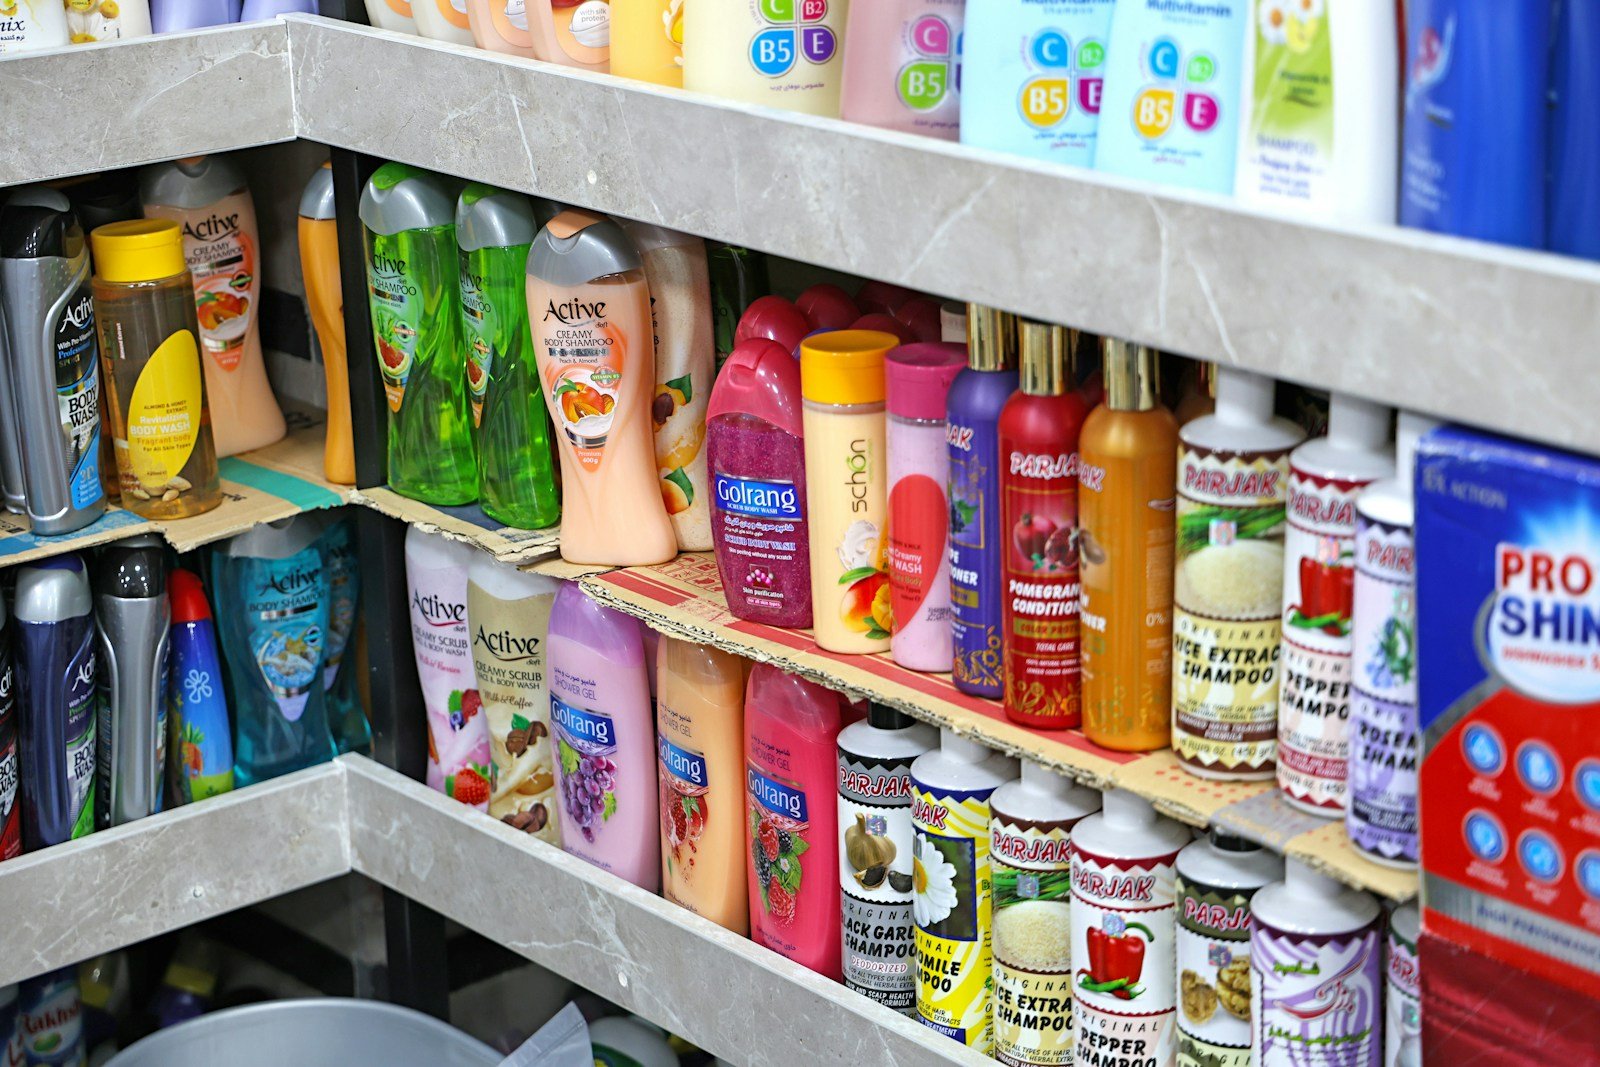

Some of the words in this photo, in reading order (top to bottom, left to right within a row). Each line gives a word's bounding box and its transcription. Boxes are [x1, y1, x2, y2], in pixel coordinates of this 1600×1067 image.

[805, 1, 823, 15] B2
[1146, 0, 1232, 17] Multivitamin
[581, 15, 606, 23] protein
[923, 26, 940, 47] C
[760, 39, 791, 63] B5
[813, 32, 824, 54] E
[1042, 38, 1058, 61] C
[1156, 50, 1171, 72] C
[908, 70, 942, 98] B5
[1029, 87, 1064, 115] B5
[1140, 96, 1170, 128] B5
[1191, 96, 1206, 126] E
[183, 212, 239, 241] Active
[193, 241, 231, 256] CREAMY
[204, 246, 246, 261] SHAMPOO
[376, 278, 417, 296] SHAMPOO
[543, 298, 607, 327] Active
[545, 338, 564, 347] BODY
[566, 337, 614, 347] SHAMPOO
[556, 330, 593, 339] CREAMY
[68, 385, 97, 414] BODY
[140, 413, 190, 424] Revitalizing
[166, 406, 188, 414] EXTRACT
[130, 425, 158, 435] BODY
[160, 422, 191, 433] WASH
[137, 436, 171, 446] Fragrant
[173, 434, 191, 442] body
[1184, 464, 1281, 498] PARJAK
[718, 479, 796, 513] Golrang
[727, 503, 743, 511] SCRUB
[745, 505, 760, 513] BODY
[724, 534, 747, 546] SCRUB
[748, 539, 770, 550] BODY
[770, 541, 797, 551] WASH
[752, 551, 767, 559] without
[895, 550, 922, 564] Creamy
[895, 560, 922, 574] WASH
[1502, 549, 1593, 597] PRO
[754, 589, 783, 599] purification
[249, 602, 279, 612] BODY
[412, 588, 466, 625] Active
[1500, 597, 1600, 645] SHIN
[428, 643, 444, 653] BODY
[445, 649, 466, 657] WASH
[438, 636, 468, 650] SCRUB
[474, 624, 540, 661] Active
[1036, 642, 1056, 652] TOTAL
[1057, 642, 1075, 651] CARE
[475, 660, 507, 679] CREAMY
[508, 671, 543, 681] SCRUB
[1183, 661, 1274, 685] SHAMPOO
[477, 671, 490, 682] FACE
[496, 679, 515, 688] BODY
[516, 682, 540, 690] WASH
[554, 675, 581, 696] SHOWER
[582, 688, 597, 700] GEL
[581, 679, 597, 687] شامپو
[482, 688, 499, 700] Milk
[509, 695, 533, 710] Coffee
[552, 700, 609, 744] Golrang
[680, 724, 692, 738] GEL
[1204, 731, 1243, 742] FORMULA
[658, 736, 702, 783] Golrang
[752, 744, 776, 766] SHOWER
[777, 757, 791, 771] GEL
[776, 748, 791, 757] شامپو
[748, 769, 802, 819] Golrang
[1072, 861, 1156, 902] PARJAK
[843, 898, 910, 920] ORIGINA
[845, 933, 917, 959] SHAMPOO
[851, 956, 907, 973] DEODORIZED
[851, 975, 872, 987] NATURAL
[874, 981, 899, 989] HERBAL
[857, 970, 867, 978] ALL
[867, 973, 886, 981] TYPES
[995, 967, 1067, 991] ORIGINA
[856, 985, 867, 996] AND
[868, 990, 888, 999] SCALP
[889, 992, 914, 1000] HEALTH
[932, 1007, 946, 1016] HAIR
[934, 1014, 961, 1026] EXTRACTS
[1075, 1004, 1158, 1033] ORIGINAL
[923, 1020, 958, 1037] TREATMENT
[1012, 1043, 1022, 1052] ALL
[1022, 1046, 1041, 1056] TYPES
[1080, 1026, 1147, 1056] PEPPER
[1004, 1047, 1028, 1061] NATURAL
[1029, 1055, 1054, 1064] HERBAL
[1076, 1043, 1158, 1067] SHAMPOO
